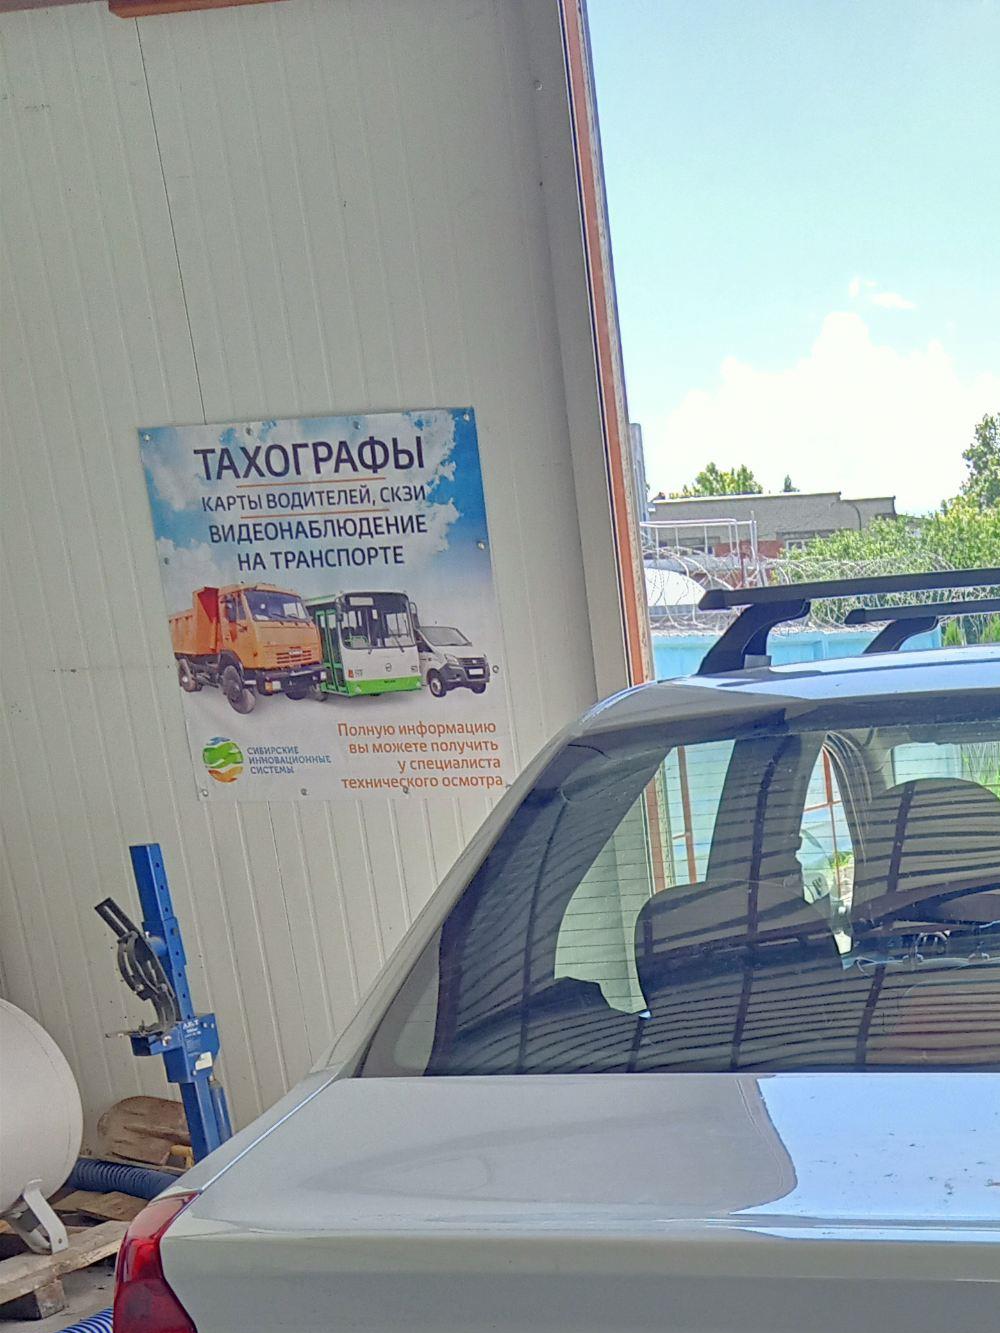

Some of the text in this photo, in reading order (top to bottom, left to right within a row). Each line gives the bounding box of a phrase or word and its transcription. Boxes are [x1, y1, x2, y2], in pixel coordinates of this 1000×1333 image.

[194, 436, 425, 480] ТАХОГРАФЫ
[202, 485, 426, 512] КАРТЫ ВОДИТЕЛЕЙ, СКЗИ
[209, 514, 428, 545] ВИДЕОНАБЛЮДЕНИЕ
[238, 545, 405, 571] НА ТРАНСПОРТЕ
[337, 720, 496, 739] Полную информацию
[246, 746, 300, 756] СИБИРСКИЕ
[349, 739, 499, 755] вы можете получить
[248, 755, 332, 765] ИННОВАЦИОННЫЕ
[397, 757, 501, 774] у специалиста
[250, 766, 295, 775] СИСТЕМЫ
[341, 775, 503, 789] технического осмотра
